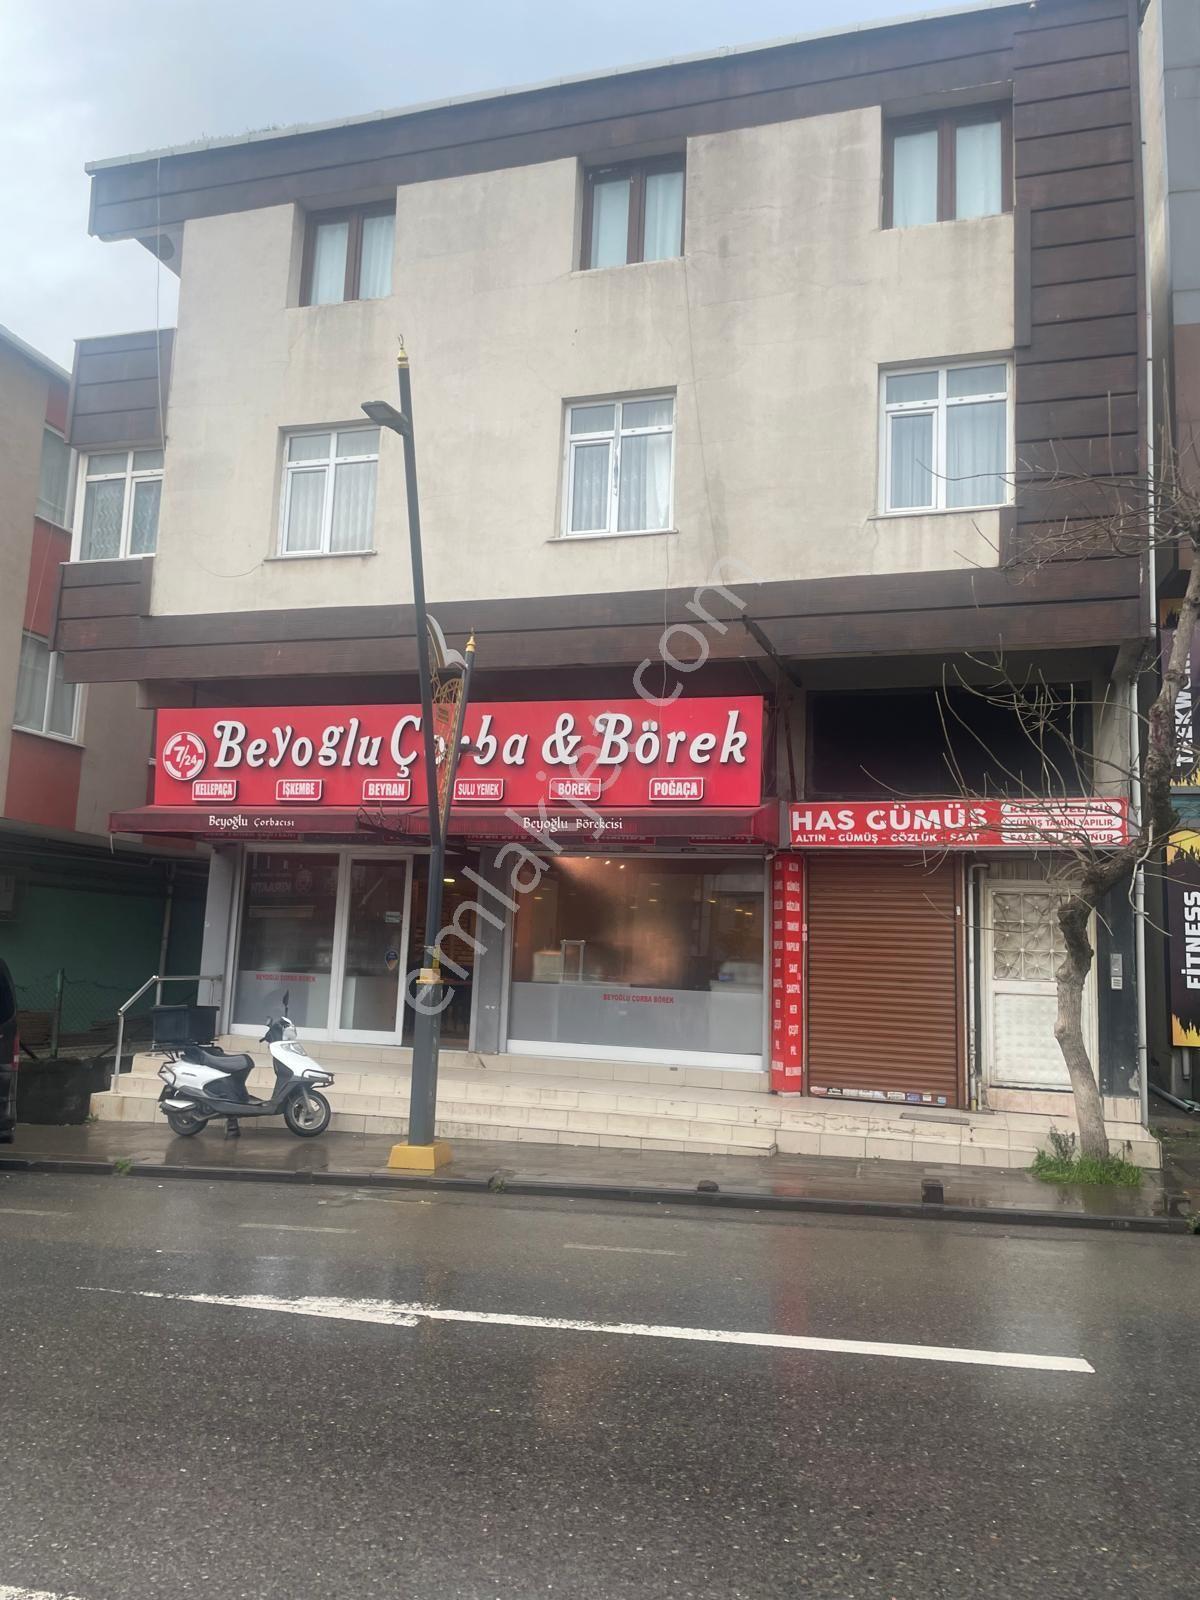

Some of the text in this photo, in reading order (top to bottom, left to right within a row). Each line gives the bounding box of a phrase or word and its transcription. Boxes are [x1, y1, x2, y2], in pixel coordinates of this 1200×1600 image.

[541, 712, 582, 765] &
[594, 710, 748, 765] Börek
[173, 744, 198, 768] 7/24
[195, 783, 233, 798] KELLEPAÇA
[282, 781, 315, 797] İŞKEMBE
[368, 783, 405, 796] BEYRAN
[458, 783, 499, 795] SULU YEMEK
[558, 781, 592, 796] BÖREK
[654, 779, 698, 798] POĞAÇA
[208, 814, 295, 830] Beyoğlu Çorbacısı
[523, 816, 623, 833] Beyoğlu Börekcisi
[792, 809, 855, 831] HAS
[796, 833, 826, 842] ALTIN
[838, 832, 878, 844] GÜMÜŞ
[890, 832, 937, 842] GÖZLÜK
[950, 832, 980, 842] SAAT
[1181, 891, 1200, 989] FİTNESS
